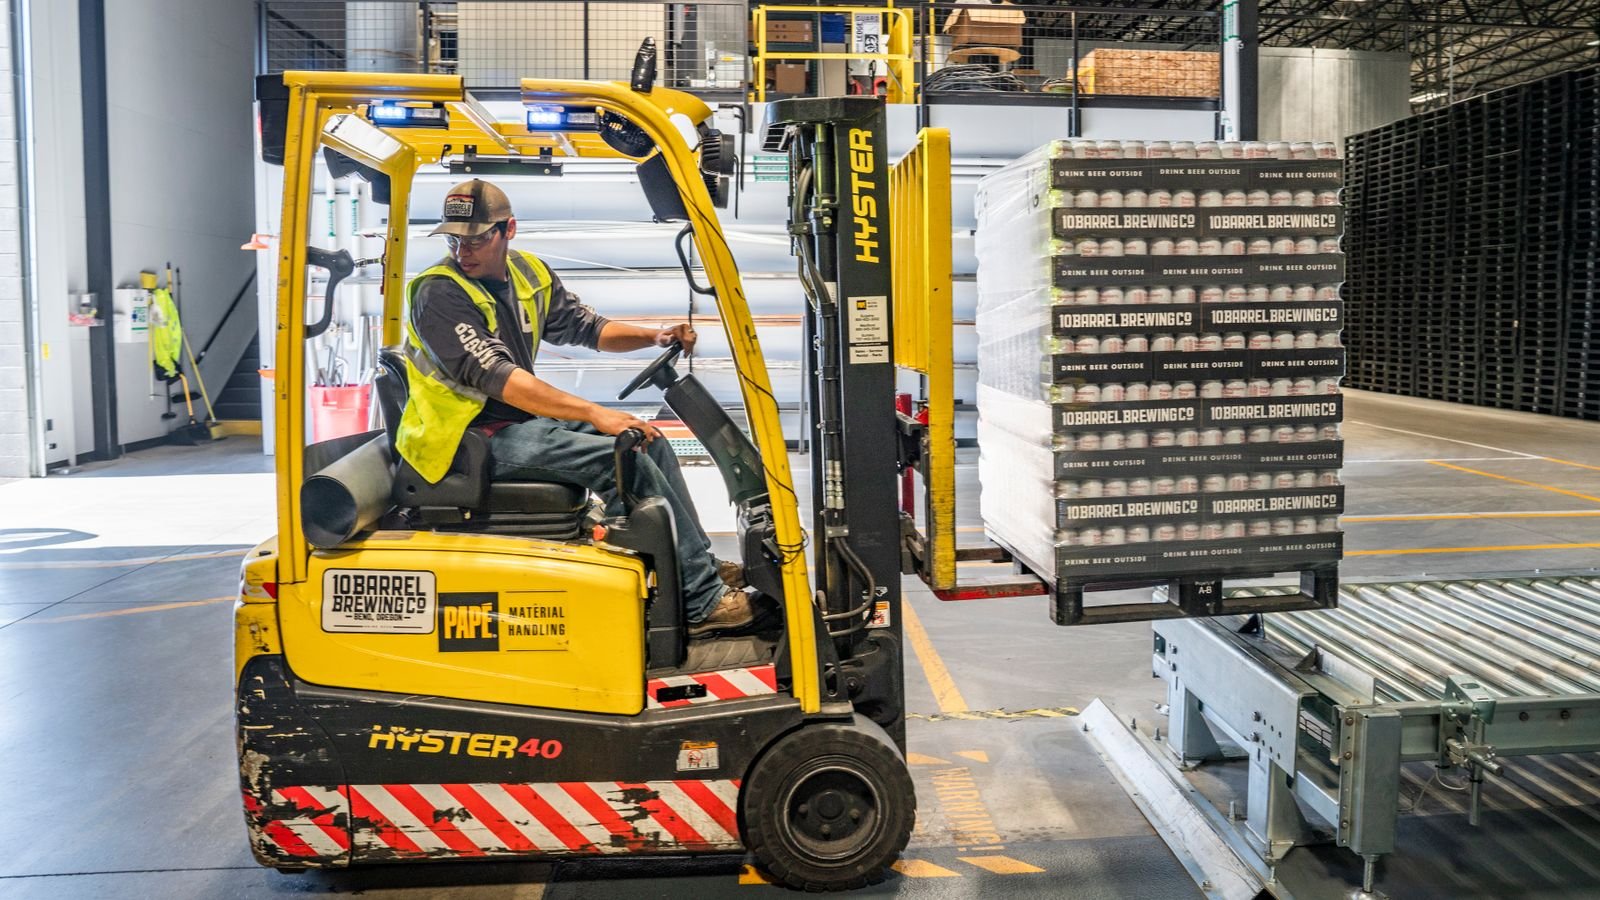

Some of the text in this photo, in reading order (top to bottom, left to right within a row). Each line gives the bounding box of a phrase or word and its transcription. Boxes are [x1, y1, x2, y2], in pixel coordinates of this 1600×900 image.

[849, 128, 879, 263] HYSTER
[508, 624, 566, 636] HANDLING
[368, 725, 563, 759] HYSTER 40
